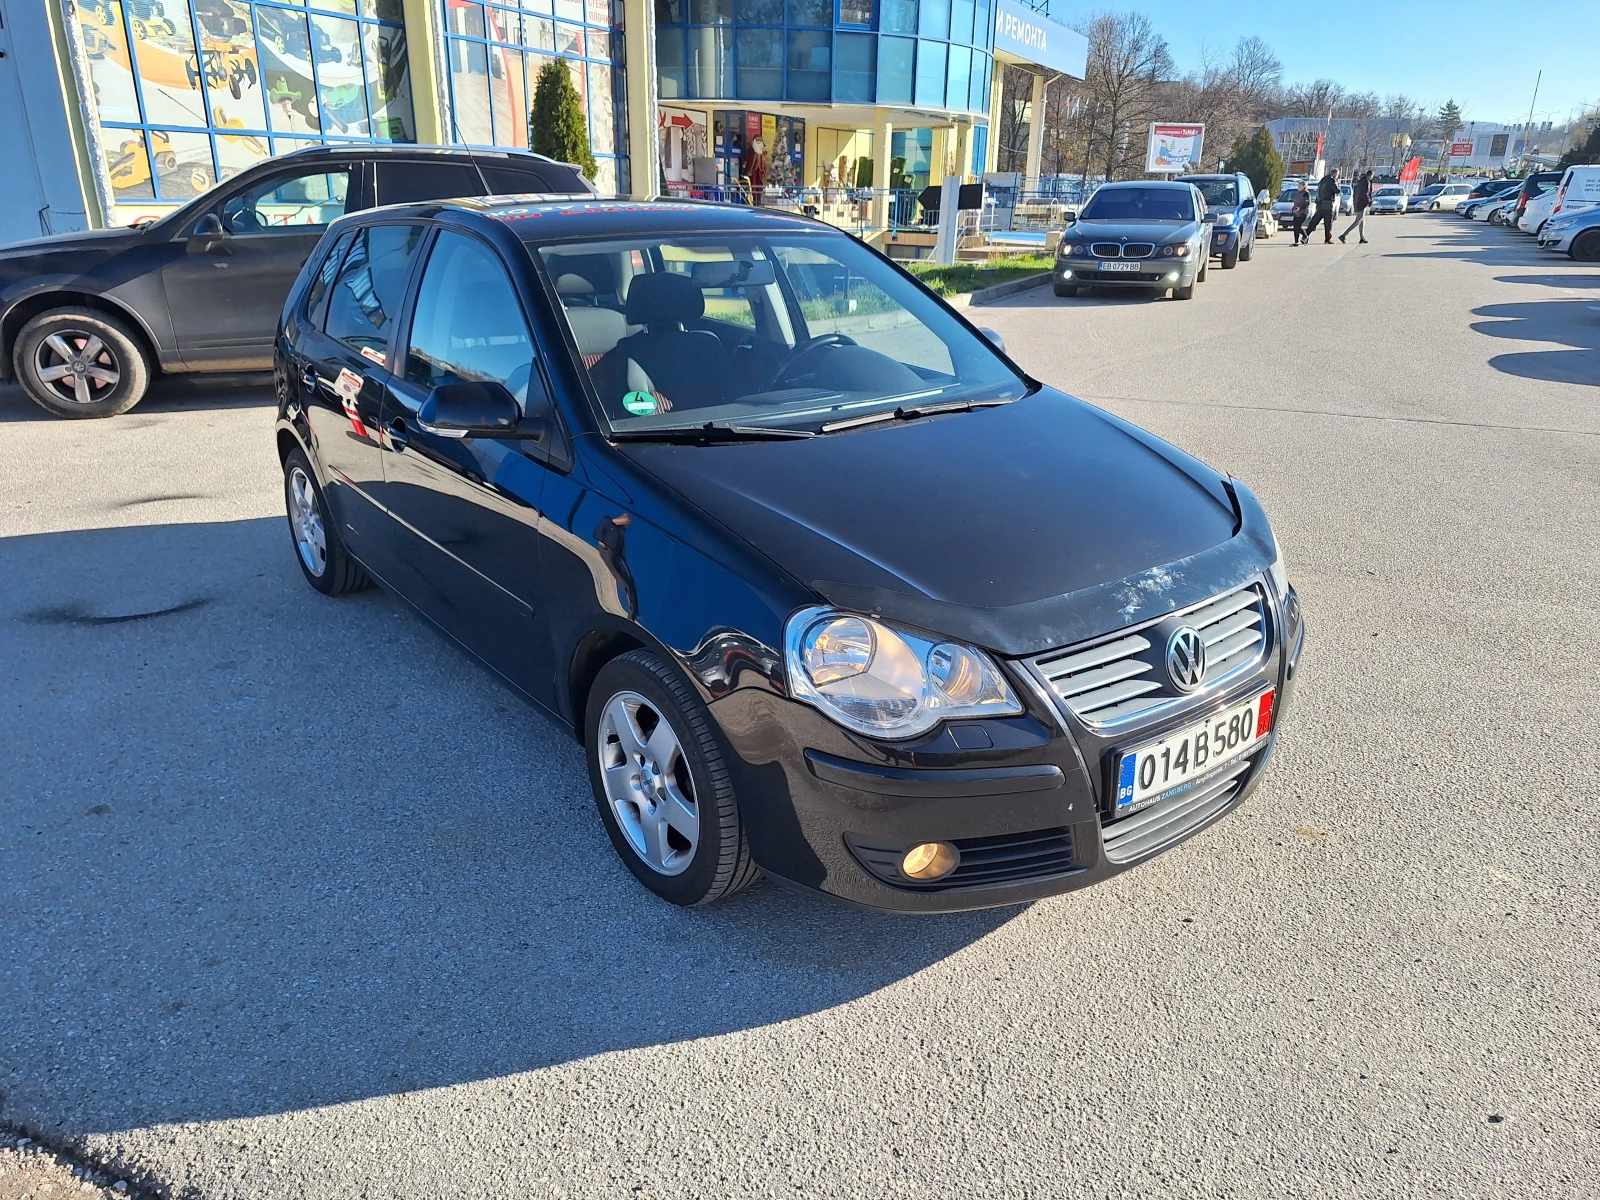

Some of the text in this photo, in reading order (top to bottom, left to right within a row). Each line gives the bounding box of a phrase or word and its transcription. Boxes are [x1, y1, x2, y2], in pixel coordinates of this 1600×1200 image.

[1005, 13, 1047, 52] РЕМОНТА
[1112, 263, 1129, 271] 0729
[634, 391, 645, 403] 4
[1120, 785, 1132, 799] BG
[1128, 795, 1161, 813] AUTOHAUS
[1161, 782, 1192, 800] ZANGBERG
